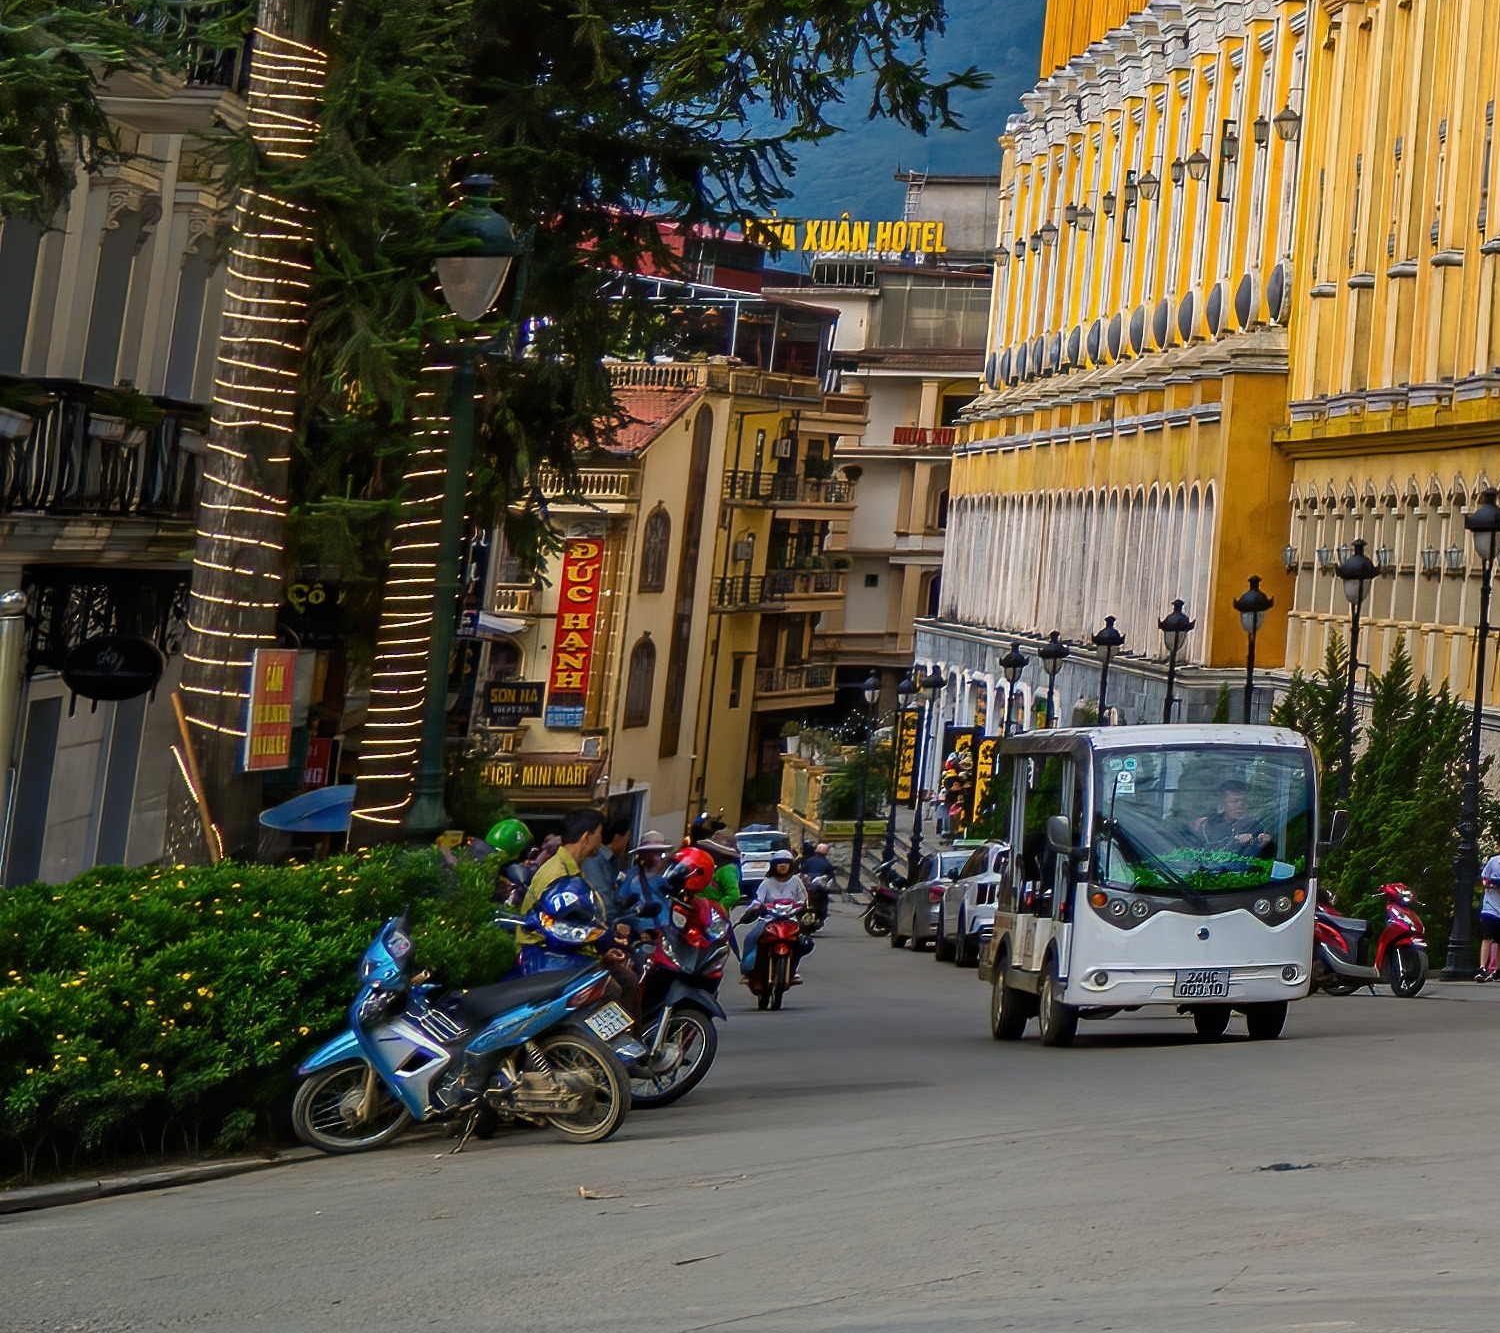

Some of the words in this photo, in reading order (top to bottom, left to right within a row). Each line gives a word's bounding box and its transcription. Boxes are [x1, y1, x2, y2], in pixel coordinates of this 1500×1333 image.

[802, 211, 870, 253] XUÂN
[874, 221, 948, 253] HOTEL
[522, 764, 552, 786] MINI
[554, 764, 590, 786] MART
